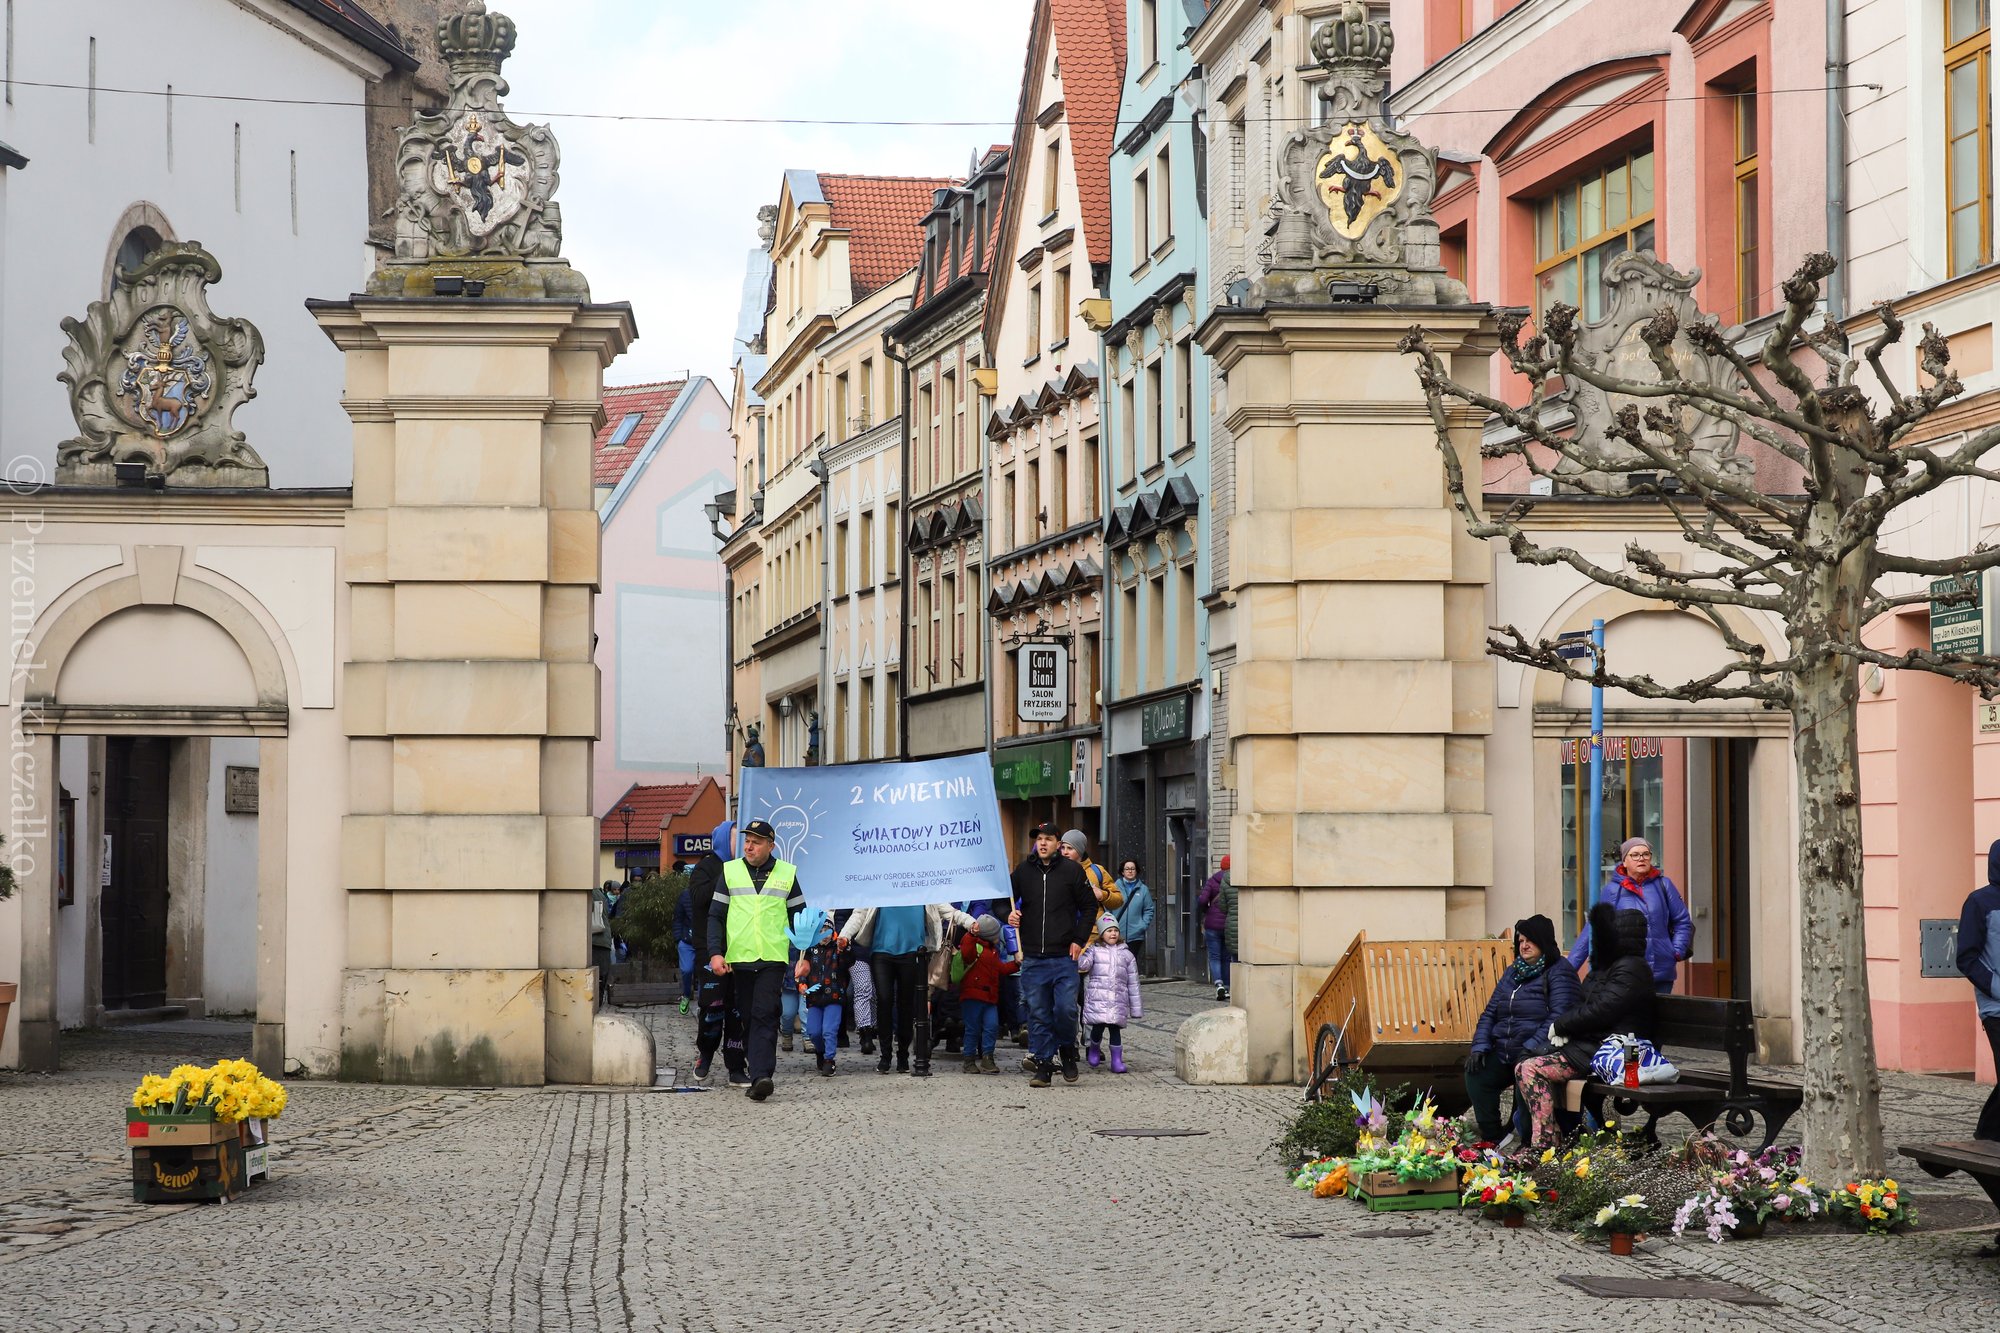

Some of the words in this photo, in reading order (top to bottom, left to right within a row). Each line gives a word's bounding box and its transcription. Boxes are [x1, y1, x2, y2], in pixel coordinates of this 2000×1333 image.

[1942, 628, 1950, 639] Jan
[1032, 652, 1053, 668] Carlo
[1032, 669, 1053, 686] Biani
[1032, 690, 1053, 698] SALON
[1023, 700, 1062, 708] FRYZJERSKI
[1989, 705, 1997, 722] 25
[850, 785, 864, 806] 2
[873, 776, 977, 805] KWIETNIA
[852, 823, 933, 842] ŚWIATOWY
[939, 813, 981, 836] DZIEŃ
[684, 838, 714, 851] CAS
[853, 840, 929, 855] ŚWIADOMOŚCI
[933, 836, 983, 850] AUTYZMU
[844, 873, 882, 882] SPECJALNY
[883, 871, 916, 880] OŚRODEK
[917, 864, 996, 879] SZKOLNO-WYCHOWAWCZY
[900, 879, 929, 888] JELENIEJ
